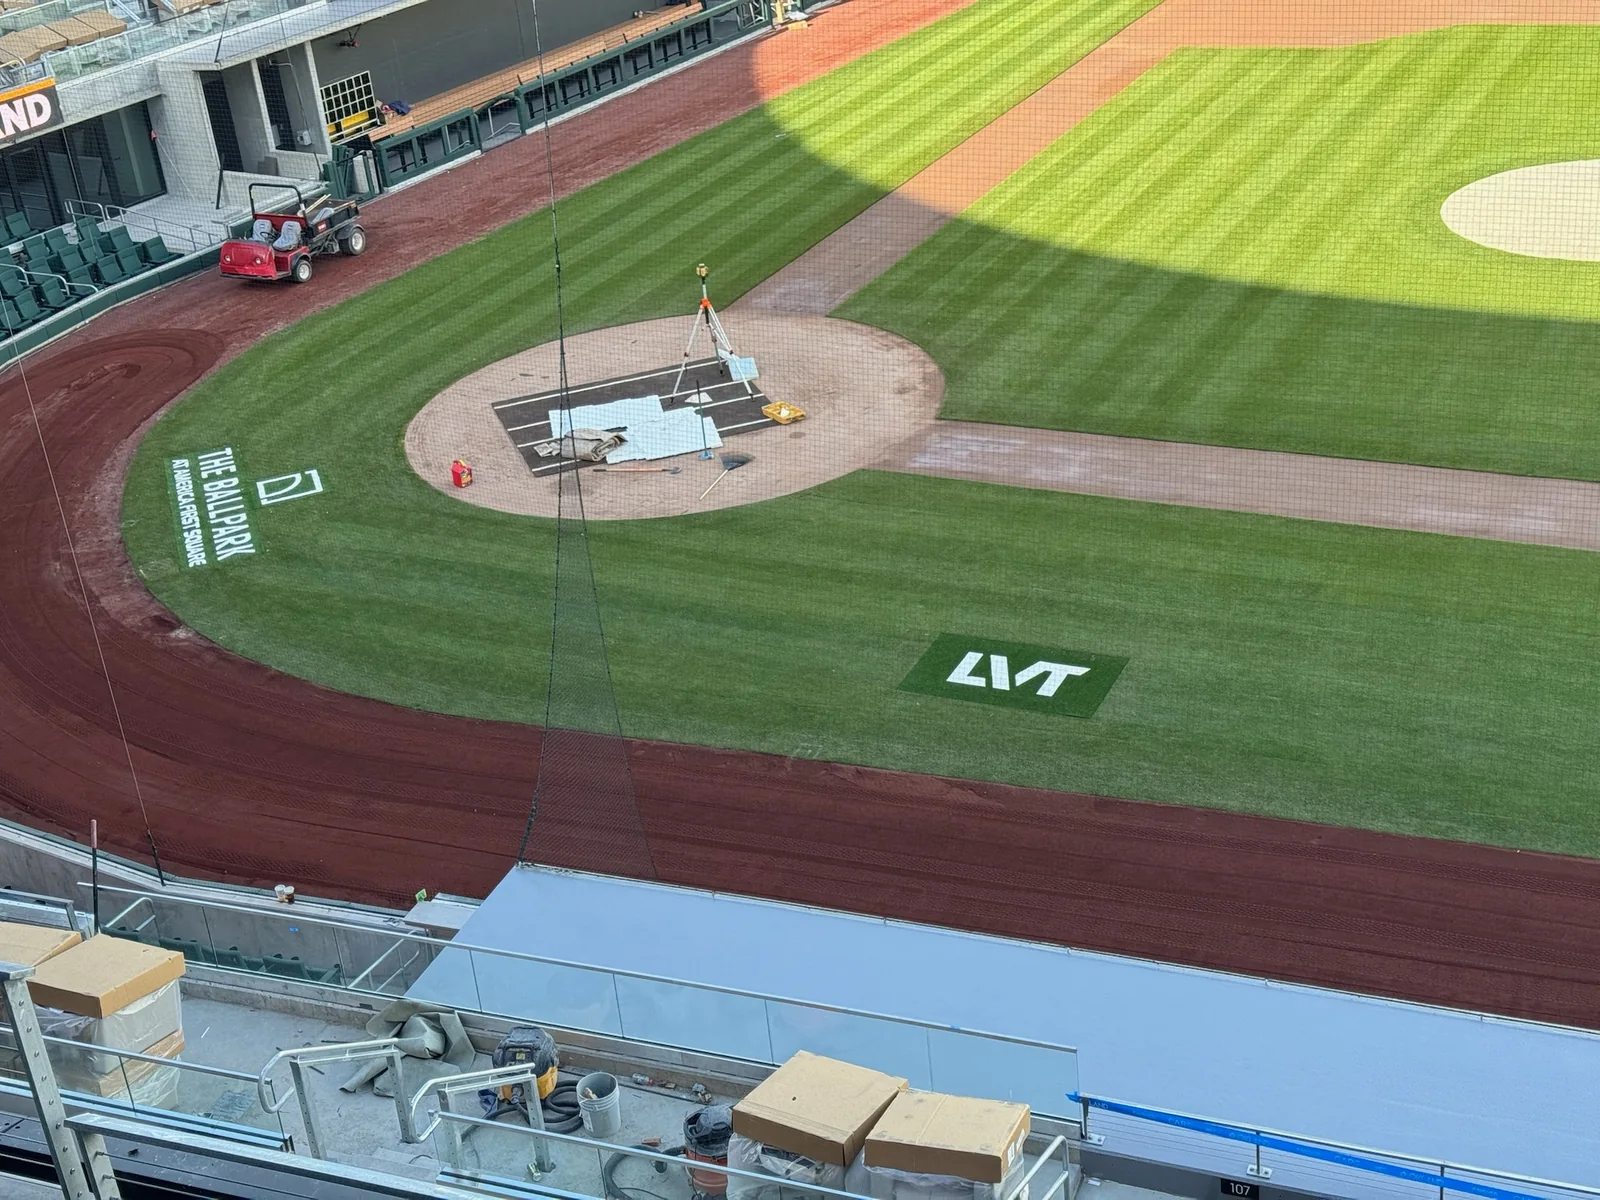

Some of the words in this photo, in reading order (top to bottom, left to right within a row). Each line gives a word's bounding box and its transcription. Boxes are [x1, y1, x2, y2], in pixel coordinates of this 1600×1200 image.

[172, 459, 189, 469] AT
[198, 447, 237, 479] THE
[173, 469, 195, 505] AMERICA
[179, 504, 200, 529] FIRST
[203, 477, 256, 561] BALLPARK
[183, 529, 207, 567] SQUARE
[946, 651, 1091, 697] LVT
[1229, 1182, 1251, 1196] 107
